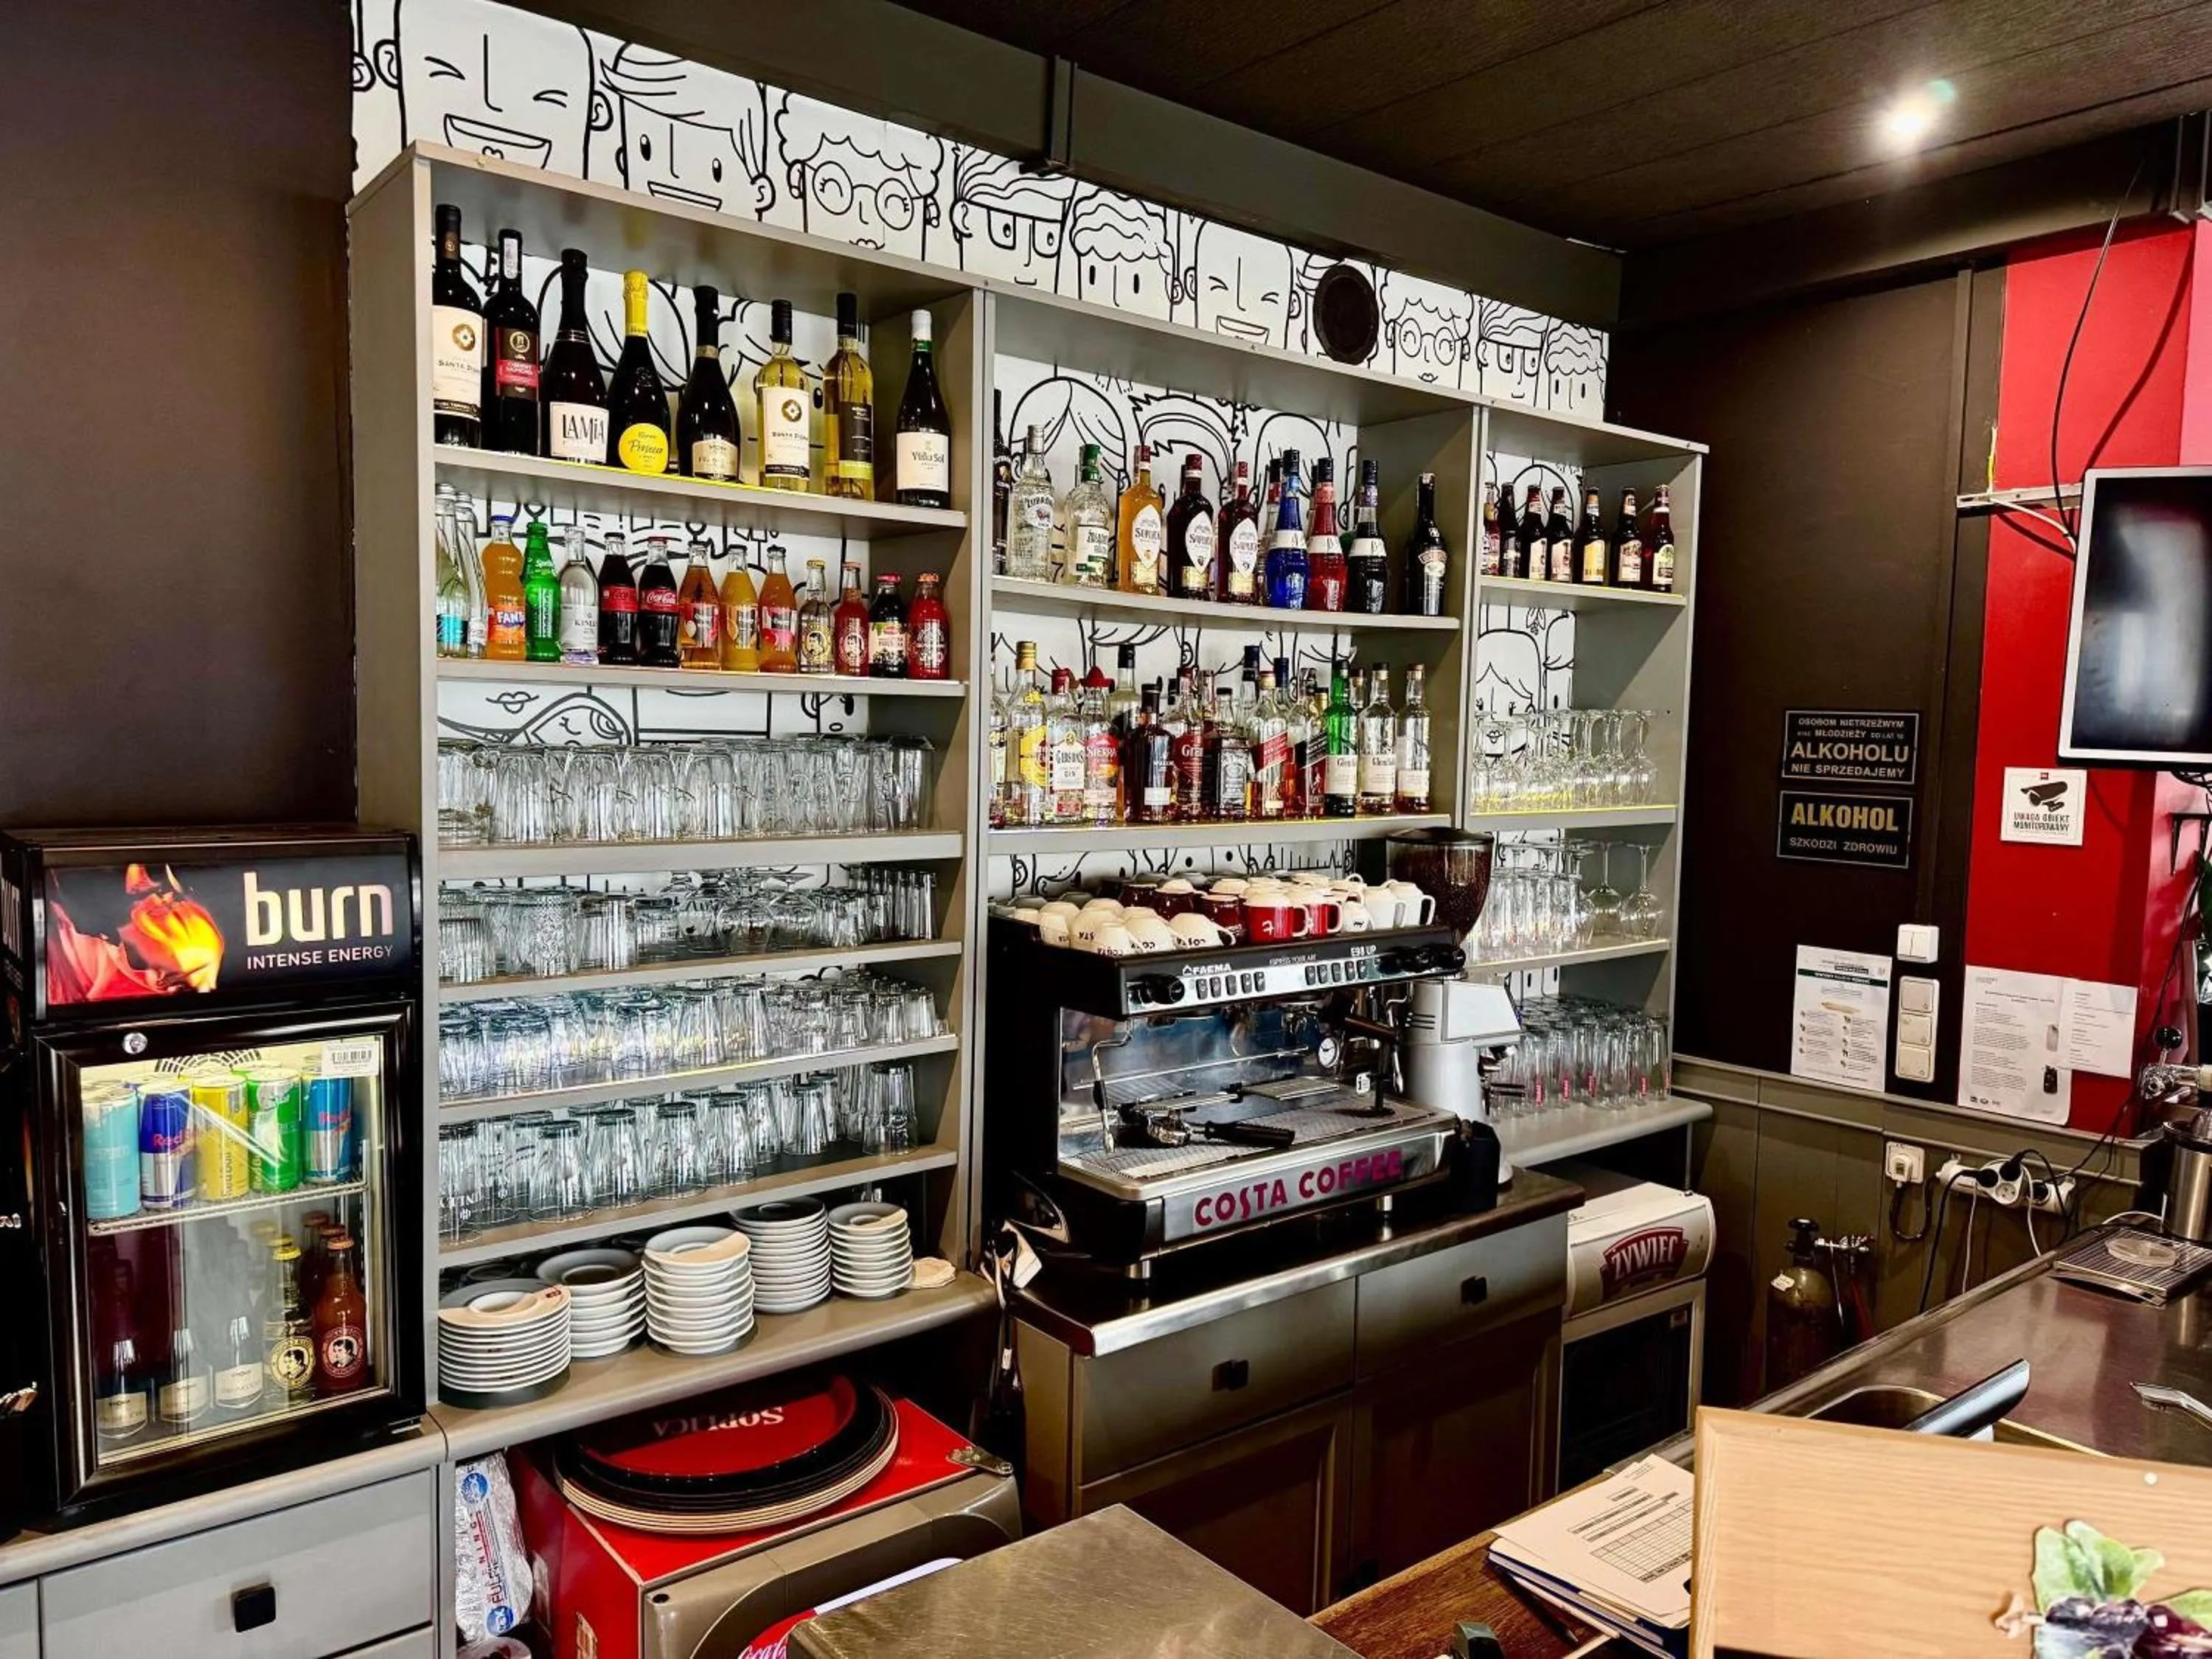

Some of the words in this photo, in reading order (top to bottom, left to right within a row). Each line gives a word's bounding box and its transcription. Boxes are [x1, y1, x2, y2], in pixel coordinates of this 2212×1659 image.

[1798, 718, 1837, 726] OSOBOM
[1815, 728, 1866, 739] MŁODZIEŻY
[1790, 741, 1909, 762] ALKOHOLU
[1791, 763, 1811, 773] NIE
[1815, 765, 1905, 778] SPRZEDAJEMY
[1790, 802, 1899, 831] ALKOHOL
[1789, 838, 1837, 850] SZKODZI
[1843, 841, 1898, 855] ZDROWIU
[243, 871, 394, 946] burn
[247, 950, 323, 970] INTENSE
[327, 945, 394, 965] ENERGY
[1366, 945, 1377, 956] UP
[1193, 963, 1232, 975] FAEMA
[1194, 1178, 1287, 1227] COSTA
[1298, 1149, 1404, 1197] COFFEE
[1611, 1234, 1680, 1282] ŻYWIEC
[653, 1405, 785, 1437] SOPLICA
